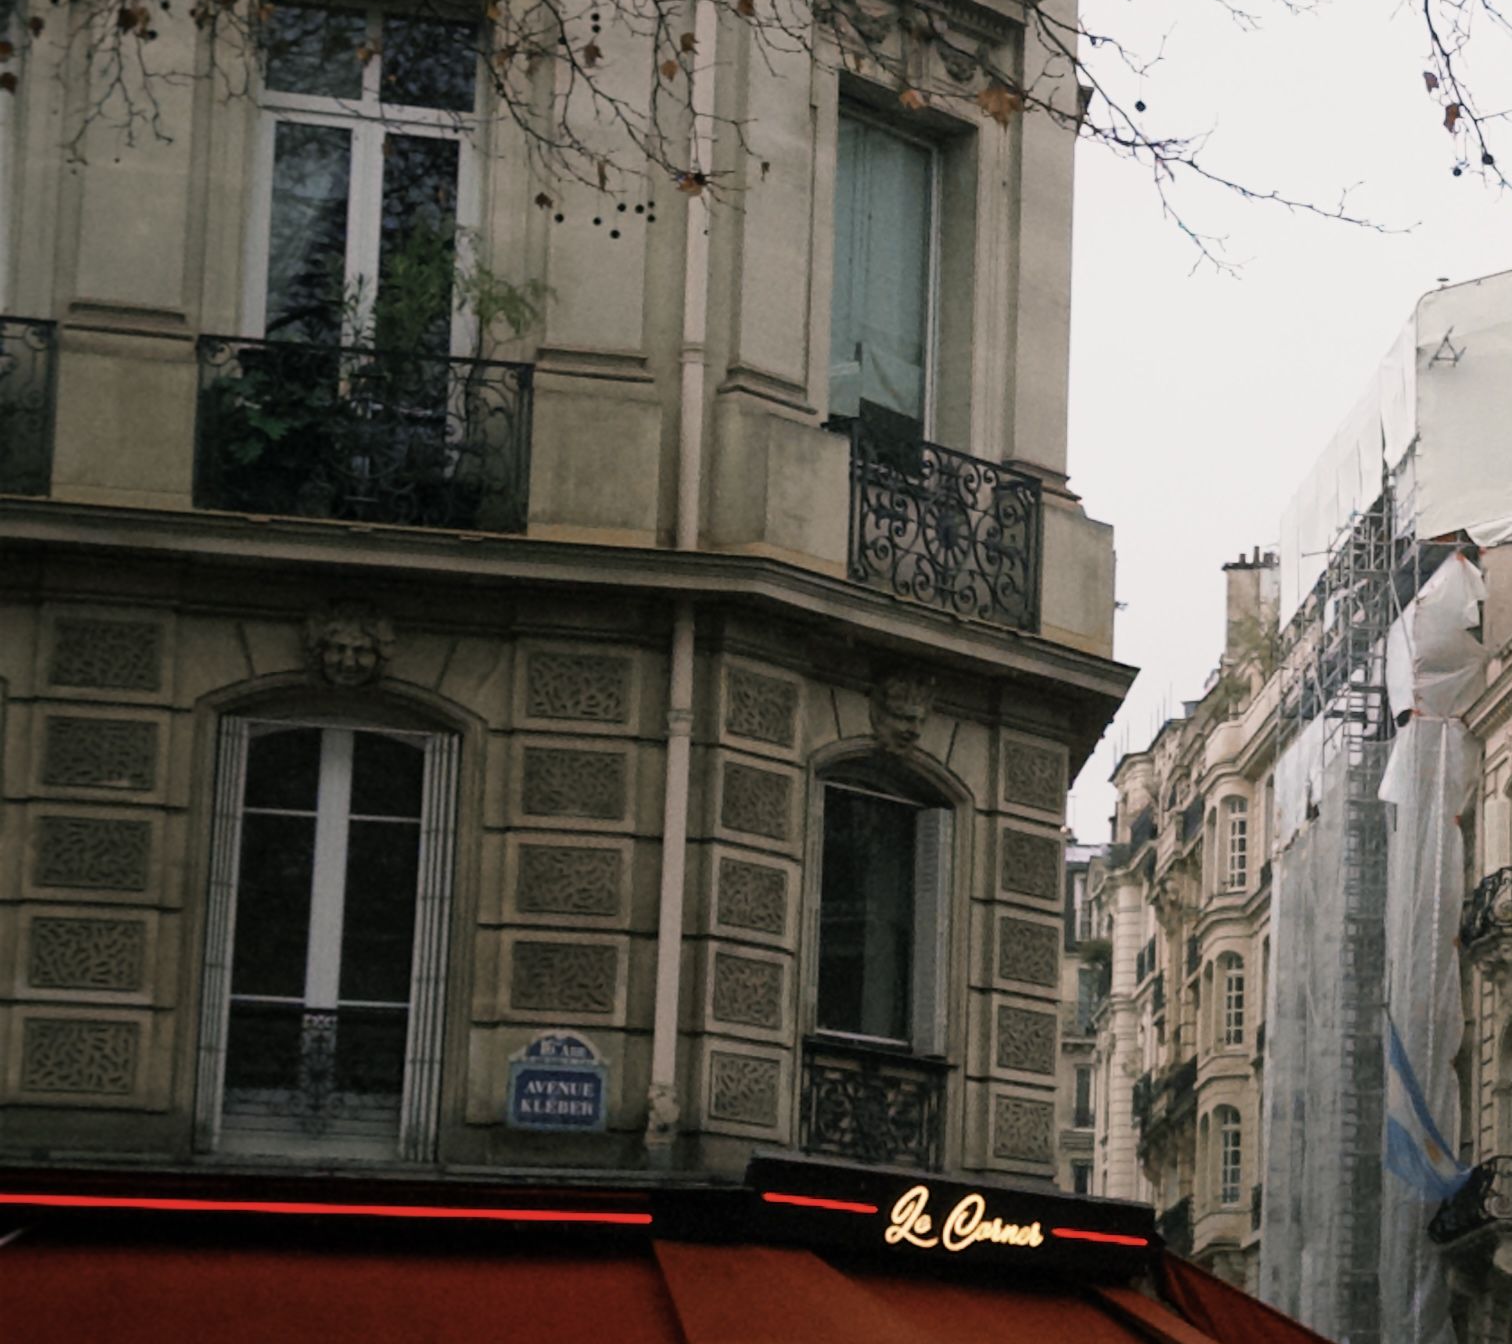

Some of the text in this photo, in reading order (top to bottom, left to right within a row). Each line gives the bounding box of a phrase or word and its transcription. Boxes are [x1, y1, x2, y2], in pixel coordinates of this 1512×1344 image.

[526, 1080, 594, 1098] AVENUE
[885, 1185, 1044, 1252] Le Corner
